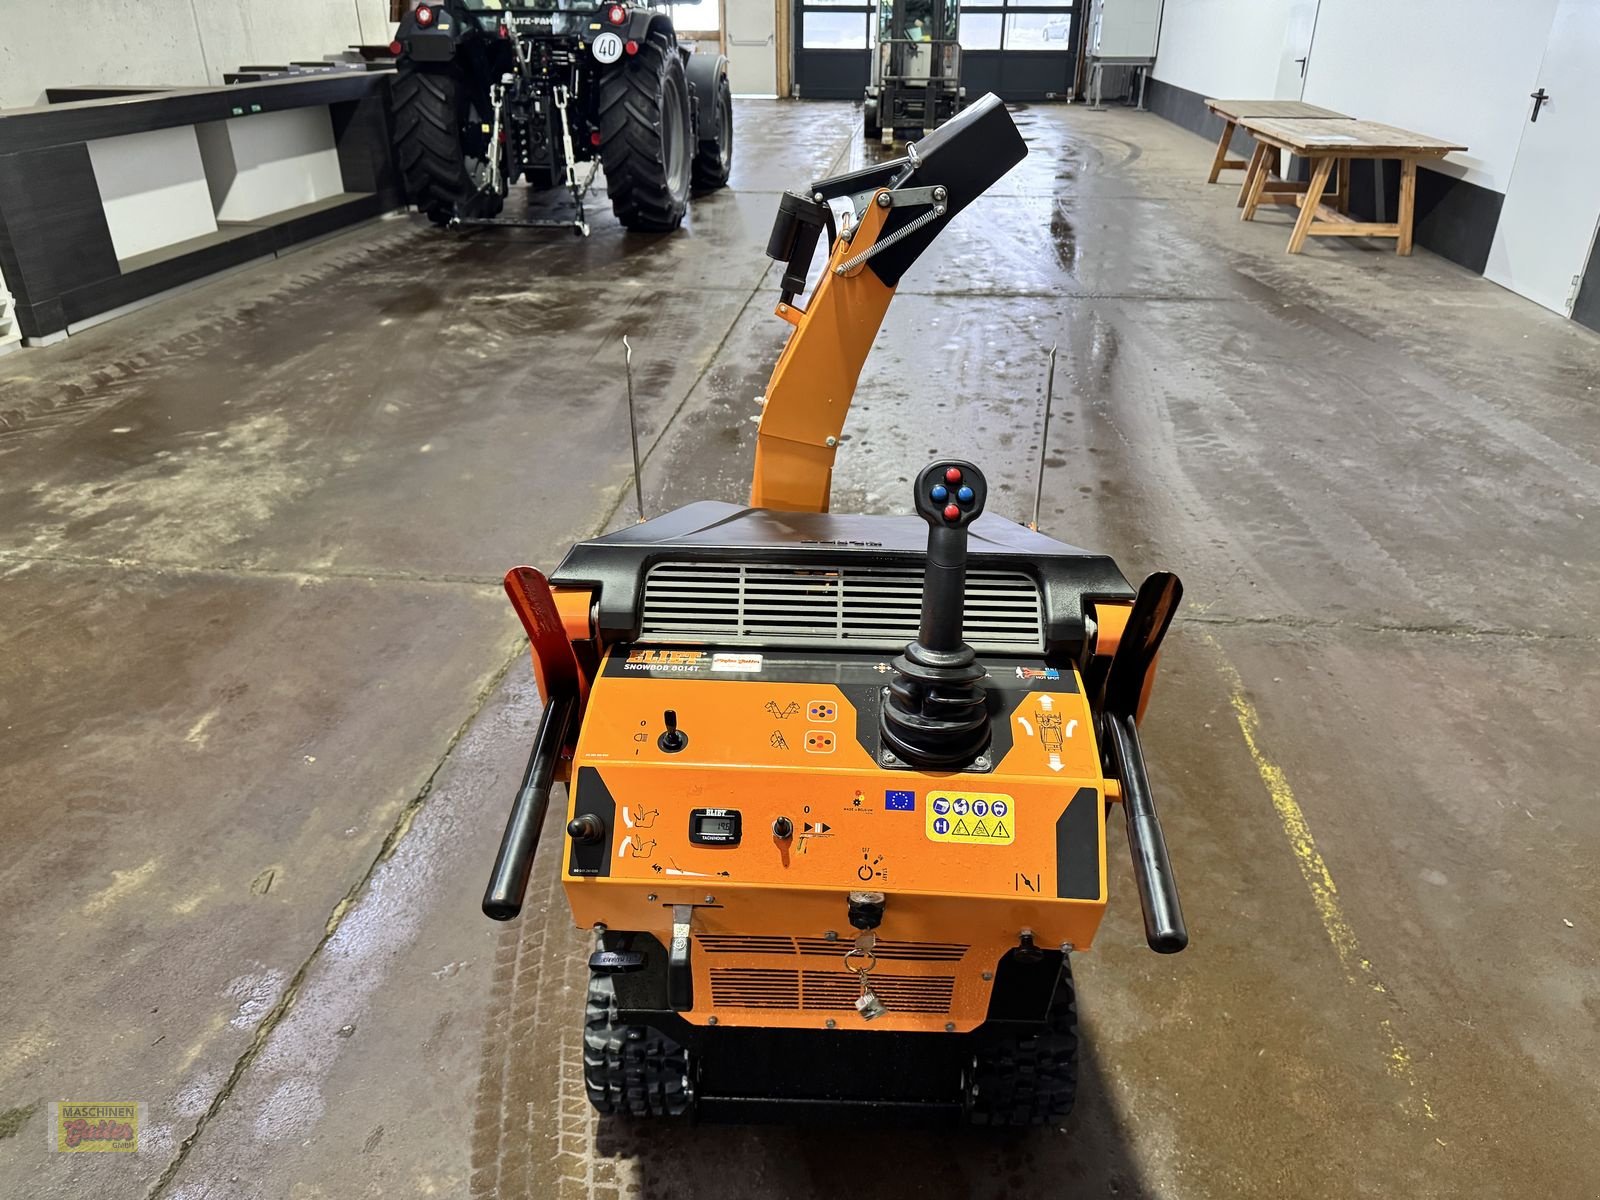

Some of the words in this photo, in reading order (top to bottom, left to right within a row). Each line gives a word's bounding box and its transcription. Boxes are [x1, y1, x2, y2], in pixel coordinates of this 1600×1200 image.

[598, 40, 616, 57] 40
[626, 650, 702, 664] ELIET
[671, 664, 700, 672] 8014T
[705, 808, 727, 817] ELIET
